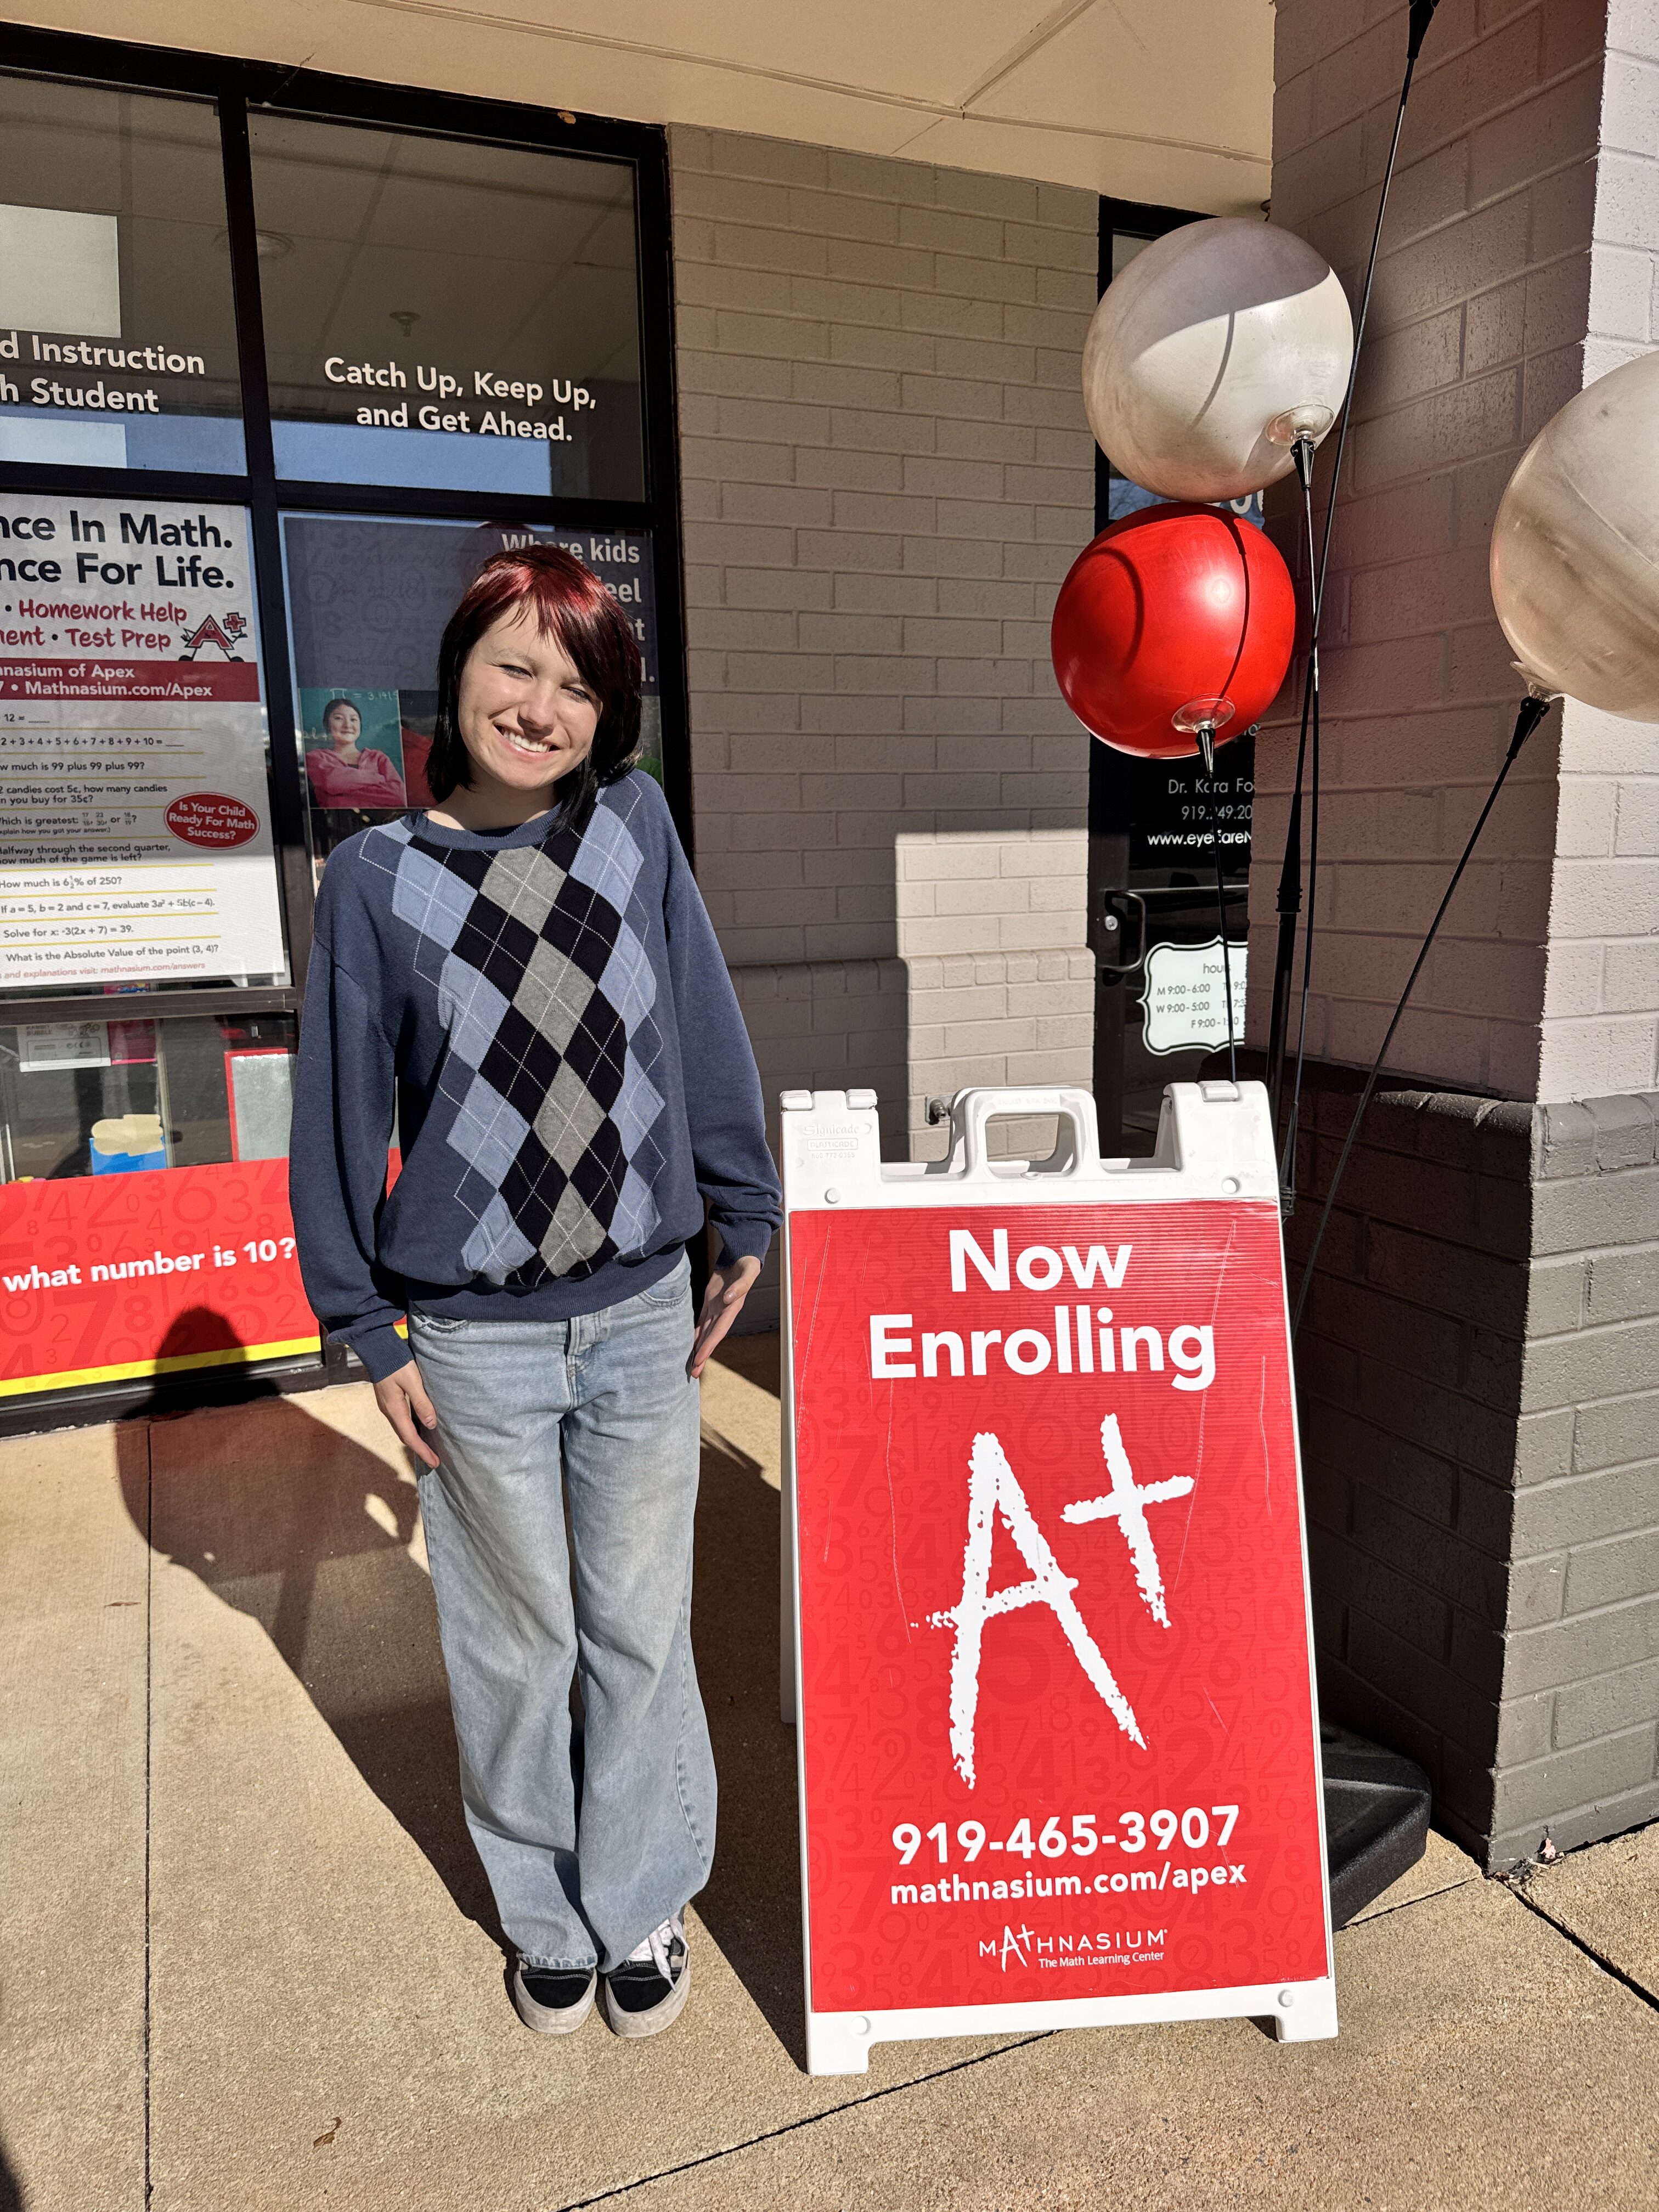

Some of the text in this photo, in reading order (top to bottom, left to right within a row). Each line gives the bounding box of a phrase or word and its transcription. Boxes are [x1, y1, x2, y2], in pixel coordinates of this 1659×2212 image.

[32, 335, 205, 375] Instruction
[325, 357, 596, 410] Catch Up, Keep Up,
[31, 377, 159, 413] Student
[357, 402, 572, 441] and Get Ahead.
[70, 510, 106, 542] In
[120, 512, 233, 548] Math.
[590, 538, 640, 563] kids
[76, 552, 143, 585] For
[156, 555, 234, 589] Life.
[596, 576, 642, 603] eel
[19, 599, 188, 626] Homework Help
[65, 627, 116, 648] Test
[121, 628, 172, 653] Prep
[69, 663, 86, 677] of
[91, 664, 135, 681] Apex
[25, 681, 213, 699] Mathnasium.com/Apex
[4, 714, 15, 722] 12
[12, 762, 38, 771] much
[41, 763, 49, 771] is
[67, 762, 88, 772] plus
[90, 762, 102, 770] 99
[105, 762, 126, 772] plus
[127, 762, 145, 770] 99?
[7, 786, 43, 794] candies
[84, 785, 104, 793] how
[106, 786, 131, 795] many
[1169, 779, 1188, 794] Dr.
[10, 795, 67, 805] you buy for
[179, 802, 246, 817] Is Your Child
[25, 816, 32, 825] is
[36, 817, 78, 827] greatest:
[168, 812, 255, 830] Ready For Math
[187, 826, 236, 840] Success?
[37, 845, 76, 856] through
[80, 845, 94, 854] the
[97, 844, 131, 853] second
[134, 844, 171, 854] quarter,
[20, 855, 46, 864] much
[49, 855, 59, 863] of
[82, 856, 109, 865] game
[121, 853, 143, 861] left?
[24, 878, 50, 887] much
[53, 878, 60, 887] is
[87, 877, 97, 885] of
[100, 876, 122, 885] 250?
[1, 905, 8, 913] If
[40, 904, 46, 912] b
[58, 903, 64, 911] 2
[66, 902, 83, 911] and
[113, 901, 149, 910] evaluate
[4, 928, 30, 938] Solve
[33, 928, 47, 937] for
[98, 926, 108, 935] 7)
[120, 925, 134, 933] 39.
[6, 953, 33, 962] What
[35, 952, 43, 961] is
[46, 951, 61, 960] the
[64, 950, 106, 959] Absolute
[109, 949, 134, 957] Value
[137, 947, 146, 955] of
[148, 946, 163, 955] the
[166, 946, 190, 956] point
[4, 970, 21, 979] and
[24, 968, 77, 978] explanations
[100, 962, 206, 975] mathnasium.com/answers
[1157, 987, 1166, 996] M
[1167, 985, 1186, 995] 9:00
[1192, 983, 1210, 994] 6:00
[1156, 1005, 1165, 1014] W
[1167, 1003, 1186, 1013] 9:00
[1191, 1001, 1209, 1012] 5:00
[1191, 1018, 1216, 1029] F 9:00
[803, 1123, 860, 1137] Signicade
[2, 1237, 296, 1293] what number is 10?
[949, 1228, 1133, 1293] Now
[870, 1305, 1216, 1391] Enrolling
[891, 1805, 1240, 1865] 919-465-3907
[890, 1861, 1247, 1904] mathnasium.com/apex
[1038, 1950, 1165, 1969] The Math Learning Center
